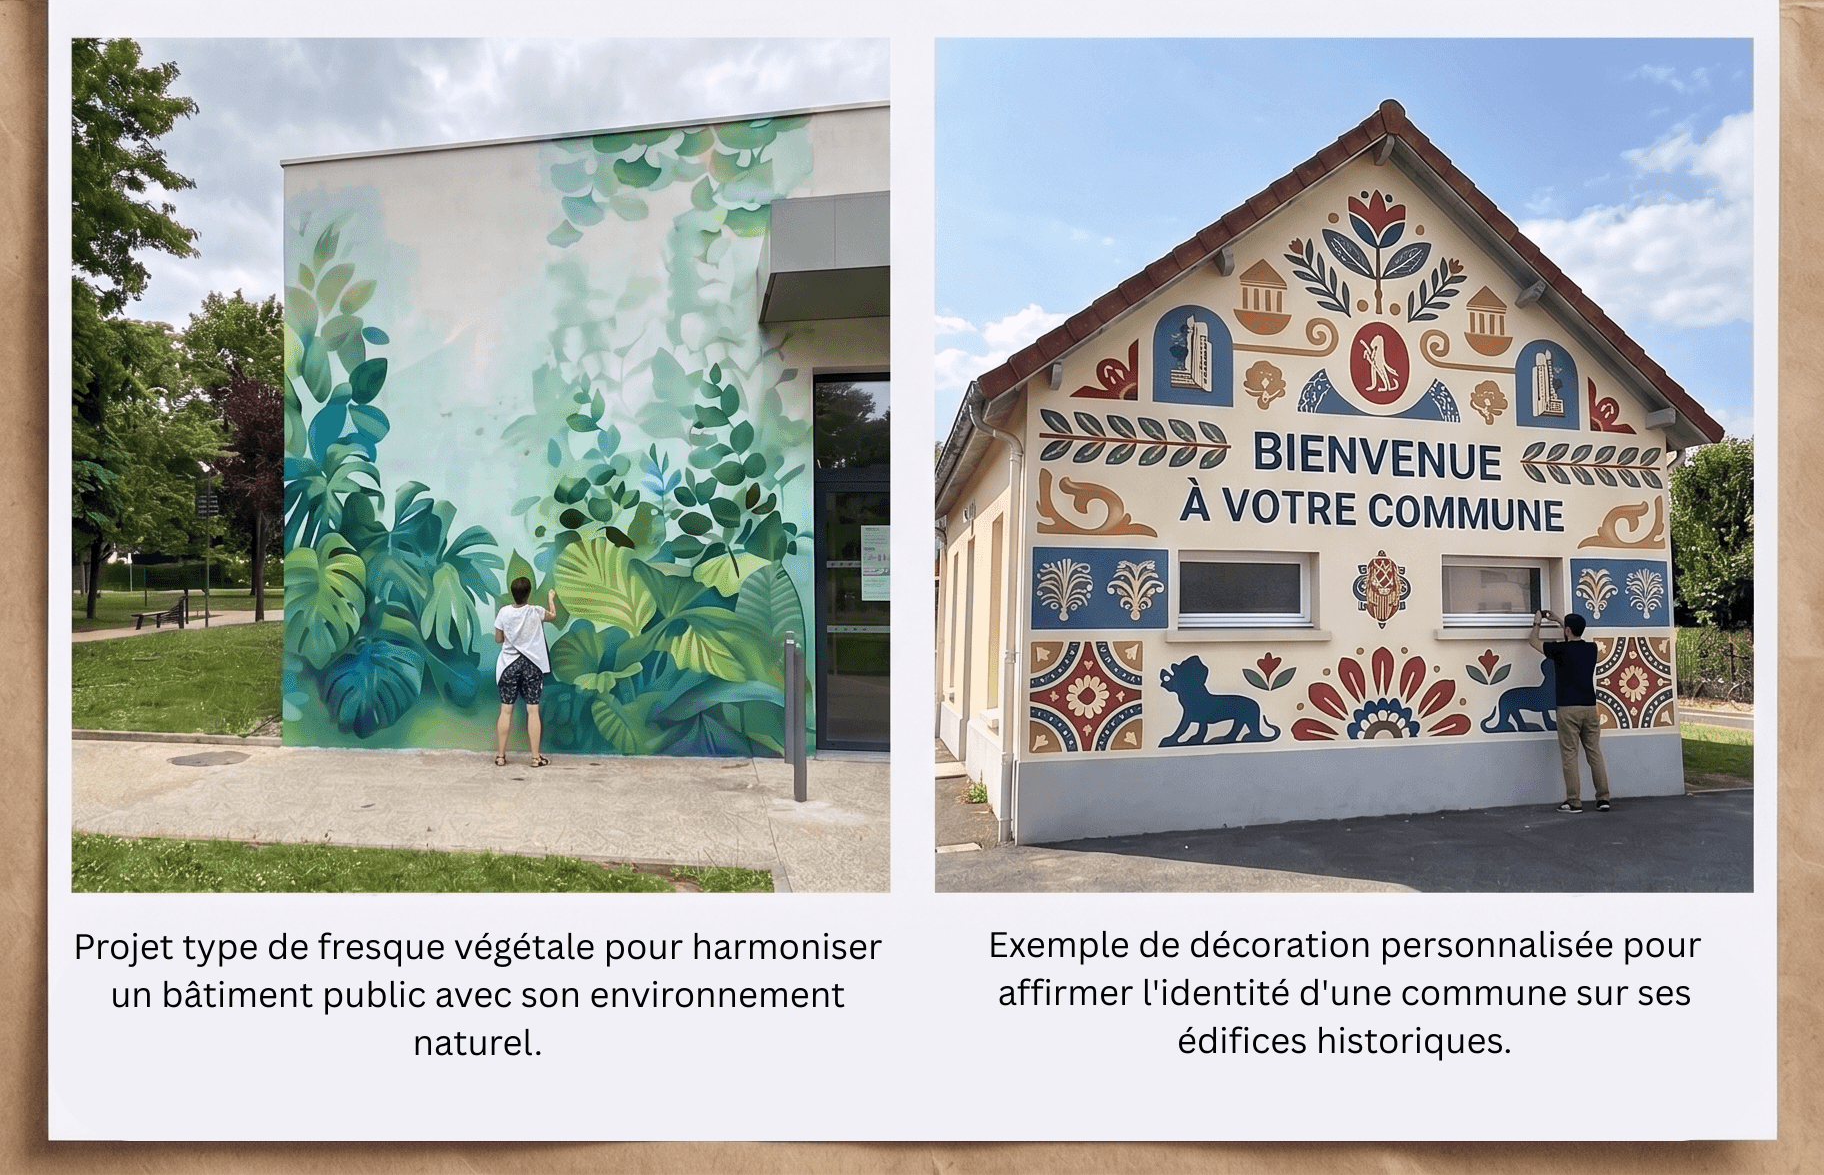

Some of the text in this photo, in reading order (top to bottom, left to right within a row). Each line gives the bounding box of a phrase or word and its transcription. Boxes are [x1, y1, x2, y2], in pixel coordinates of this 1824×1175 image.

[1254, 431, 1502, 481] BIENVENUE
[1180, 477, 1565, 532] À VOTRE COMMUNE
